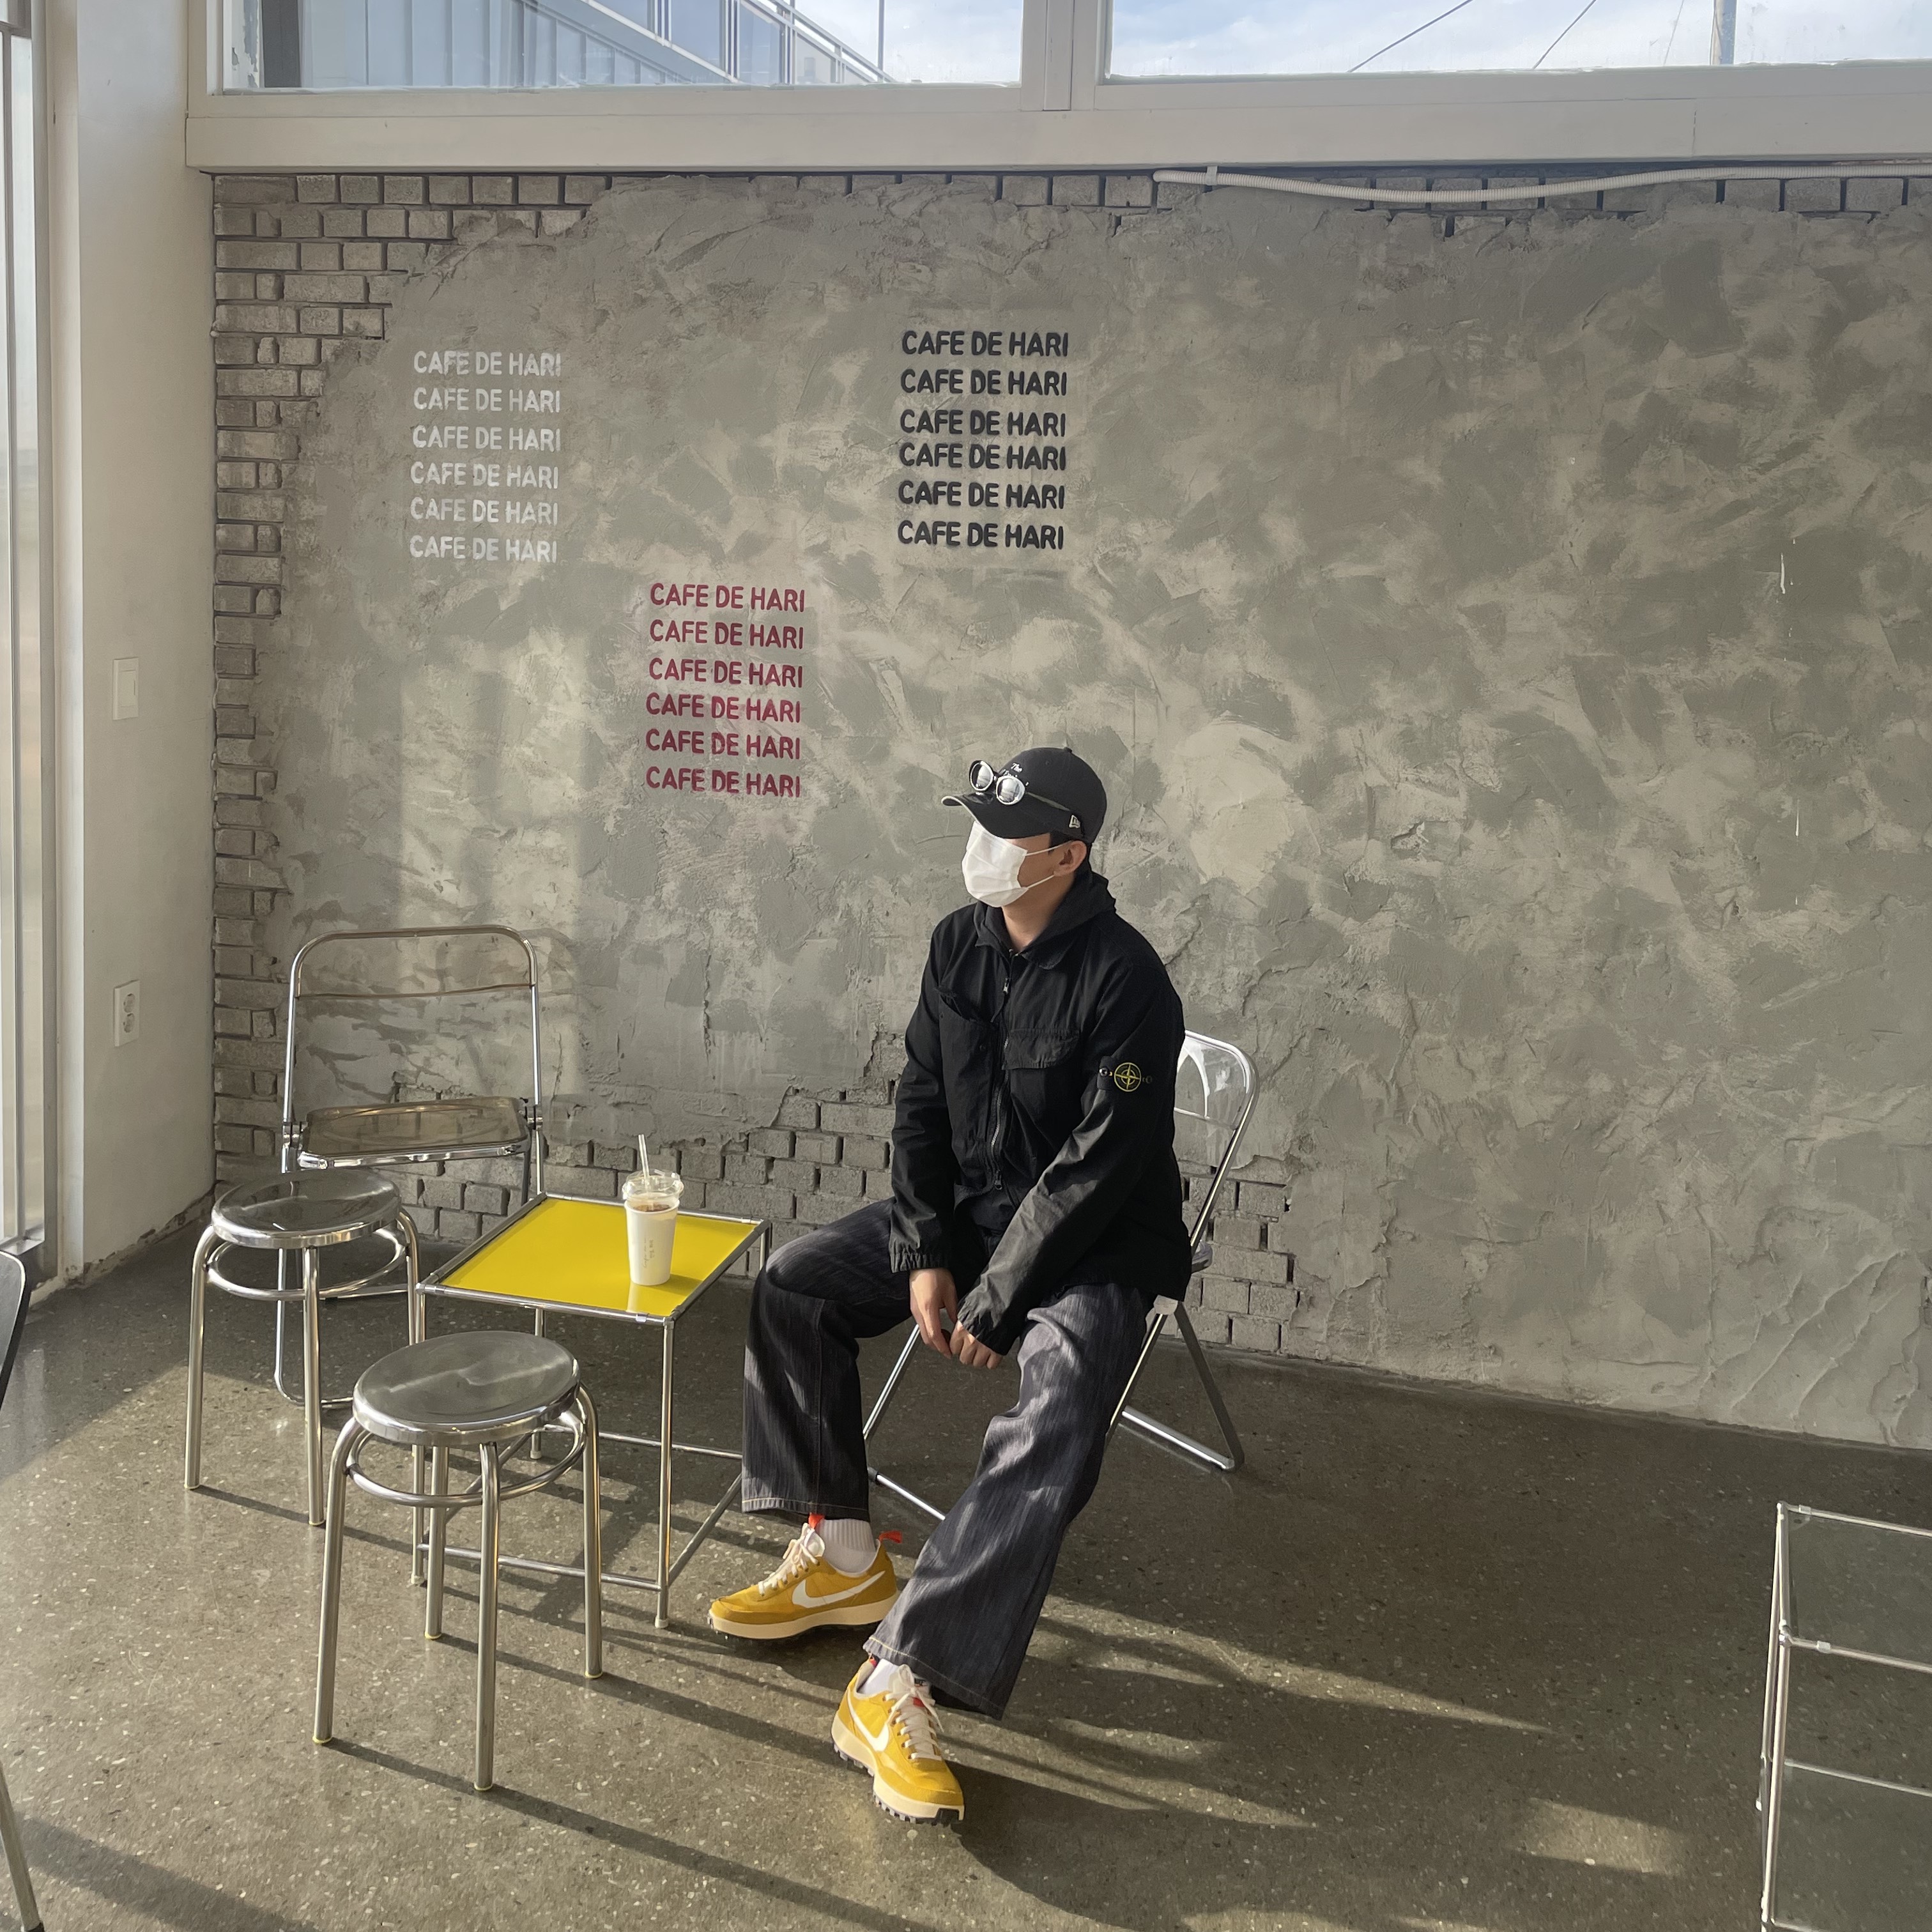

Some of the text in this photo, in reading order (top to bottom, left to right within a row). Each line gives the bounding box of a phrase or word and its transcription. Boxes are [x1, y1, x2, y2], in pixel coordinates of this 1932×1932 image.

[901, 330, 1068, 356] CAFE DE HARI
[413, 351, 561, 376] CAFE DE HARI
[901, 369, 1067, 396] CAFE DE HARI
[413, 387, 560, 413] CAFE DE HARI
[900, 409, 1066, 437] CAFE DE HARI
[412, 425, 561, 452] CAFE DE HARI
[899, 442, 1066, 470] CAFE DE HARI
[410, 461, 558, 489] CAFE DE HARI
[898, 480, 1065, 509] CAFE DE HARI
[410, 496, 558, 526] CAFE DE HARI
[898, 520, 1064, 549] CAFE DE HARI
[410, 535, 557, 563] CAFE DE HARI
[650, 582, 804, 612] CAFE DE HARI
[650, 619, 804, 649] CAFE DE HARI
[648, 657, 802, 688] CAFE DE HARI
[646, 692, 801, 723] CAFE DE HARI
[645, 728, 800, 760] CAFE DE HARI
[645, 766, 800, 798] CAFE DE HARI
